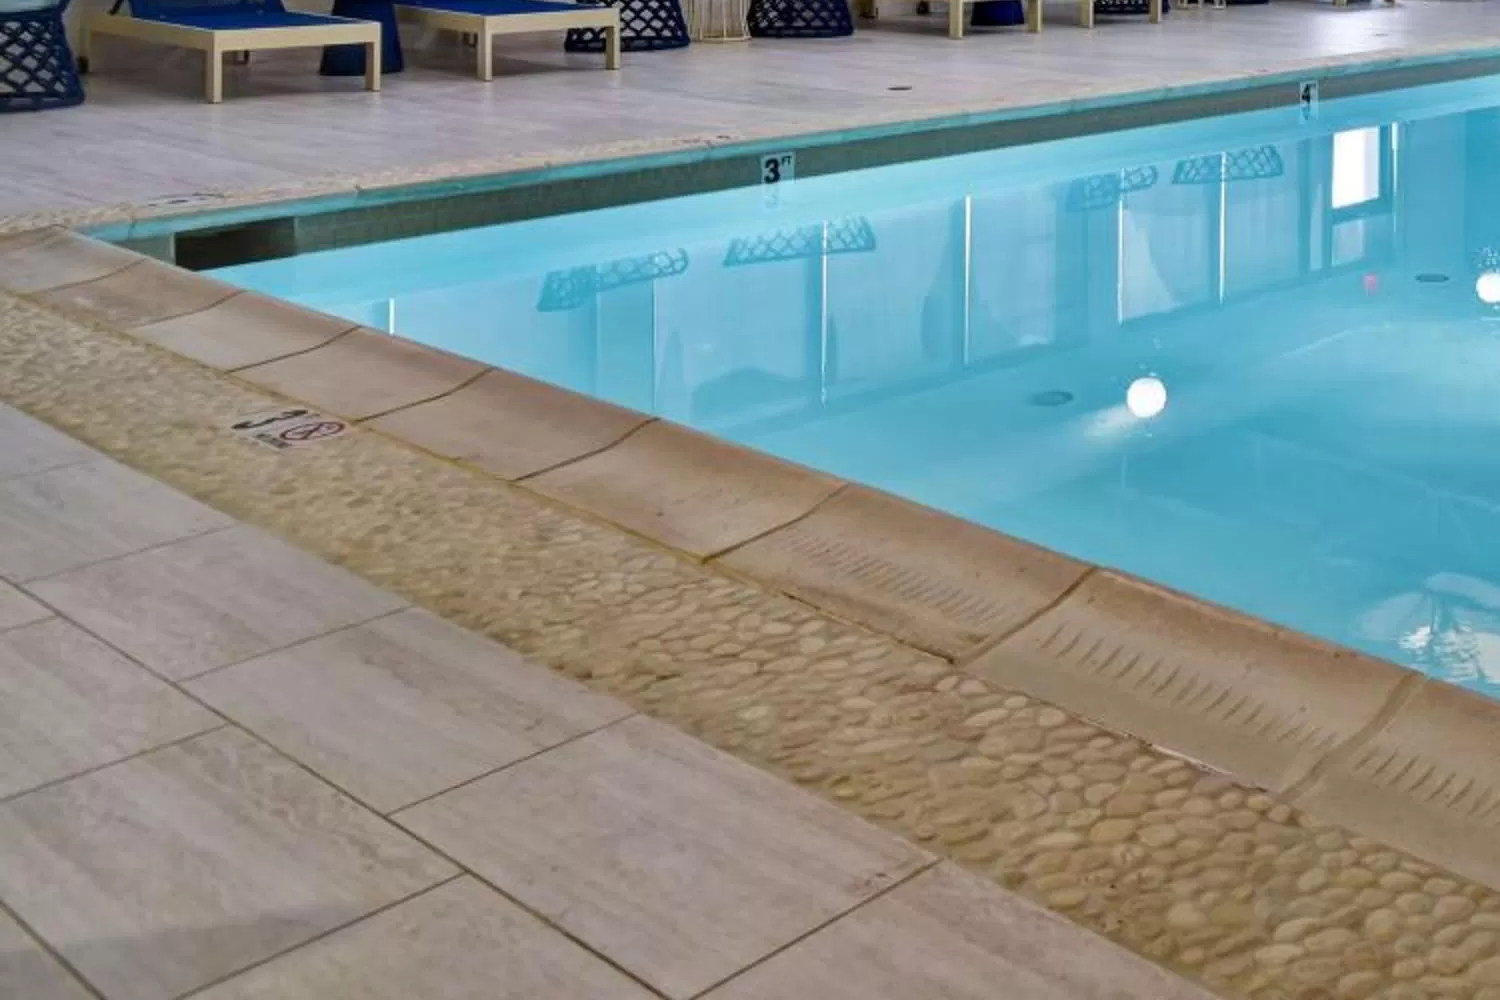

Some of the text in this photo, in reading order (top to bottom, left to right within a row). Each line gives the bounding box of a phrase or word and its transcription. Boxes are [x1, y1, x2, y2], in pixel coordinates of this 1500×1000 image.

[1301, 83, 1311, 104] 4
[764, 155, 792, 184] 3 FT
